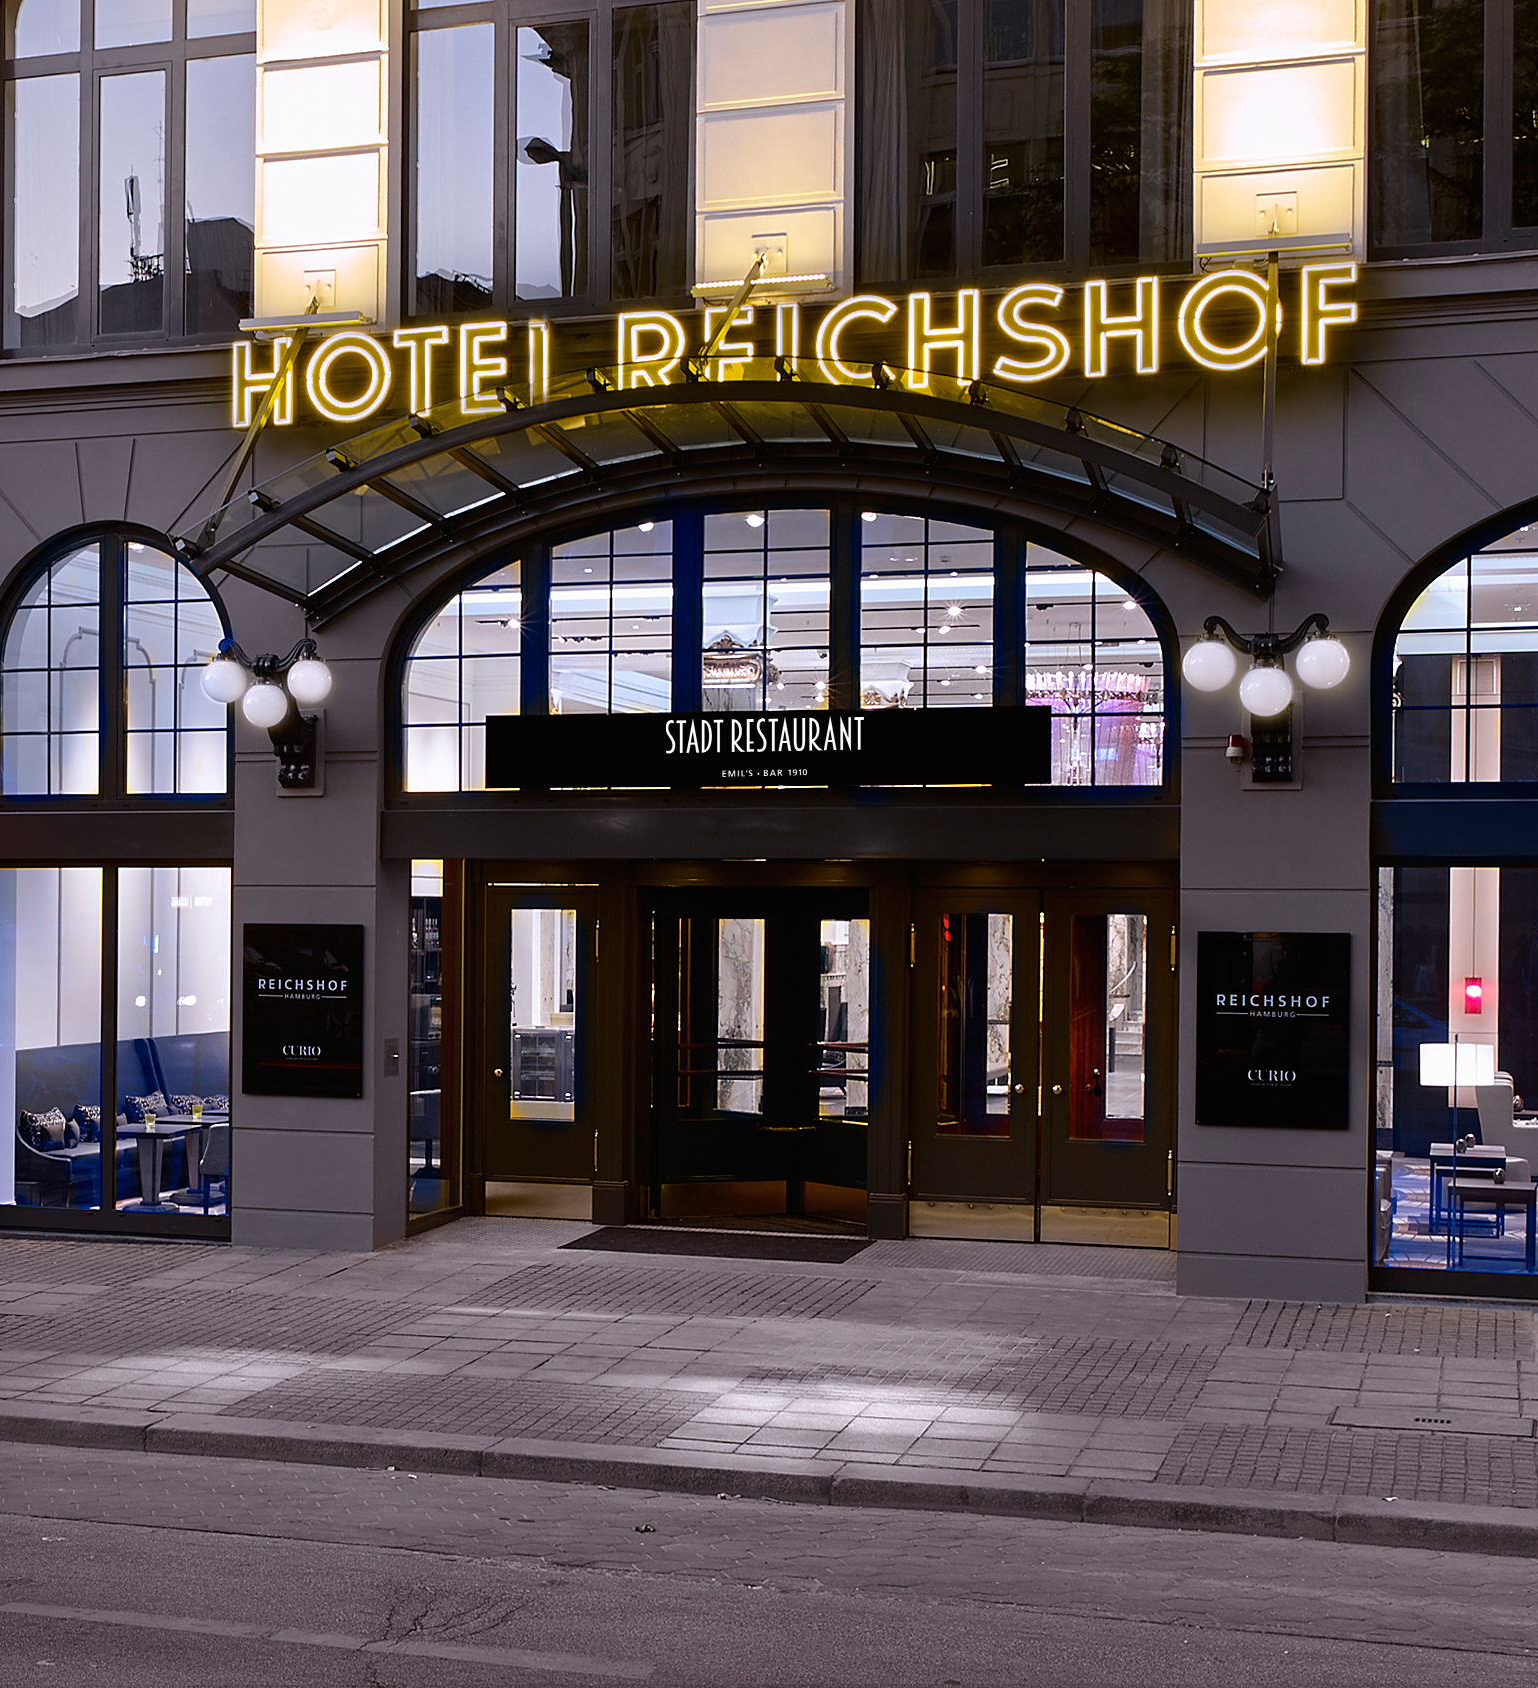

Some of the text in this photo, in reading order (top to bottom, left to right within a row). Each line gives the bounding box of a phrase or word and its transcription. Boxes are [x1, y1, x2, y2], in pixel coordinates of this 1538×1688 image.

[617, 261, 1359, 392] REICHSHOF
[665, 716, 865, 754] STADT RESTAURANT
[721, 768, 808, 778] EMIL'S BAR 1910
[258, 978, 348, 991] REICHSHOF
[1216, 993, 1330, 1008] REICHSHOF
[1249, 1010, 1296, 1018] HAMBURG
[282, 1044, 322, 1057] CURIO
[1247, 1069, 1297, 1082] CURIO
